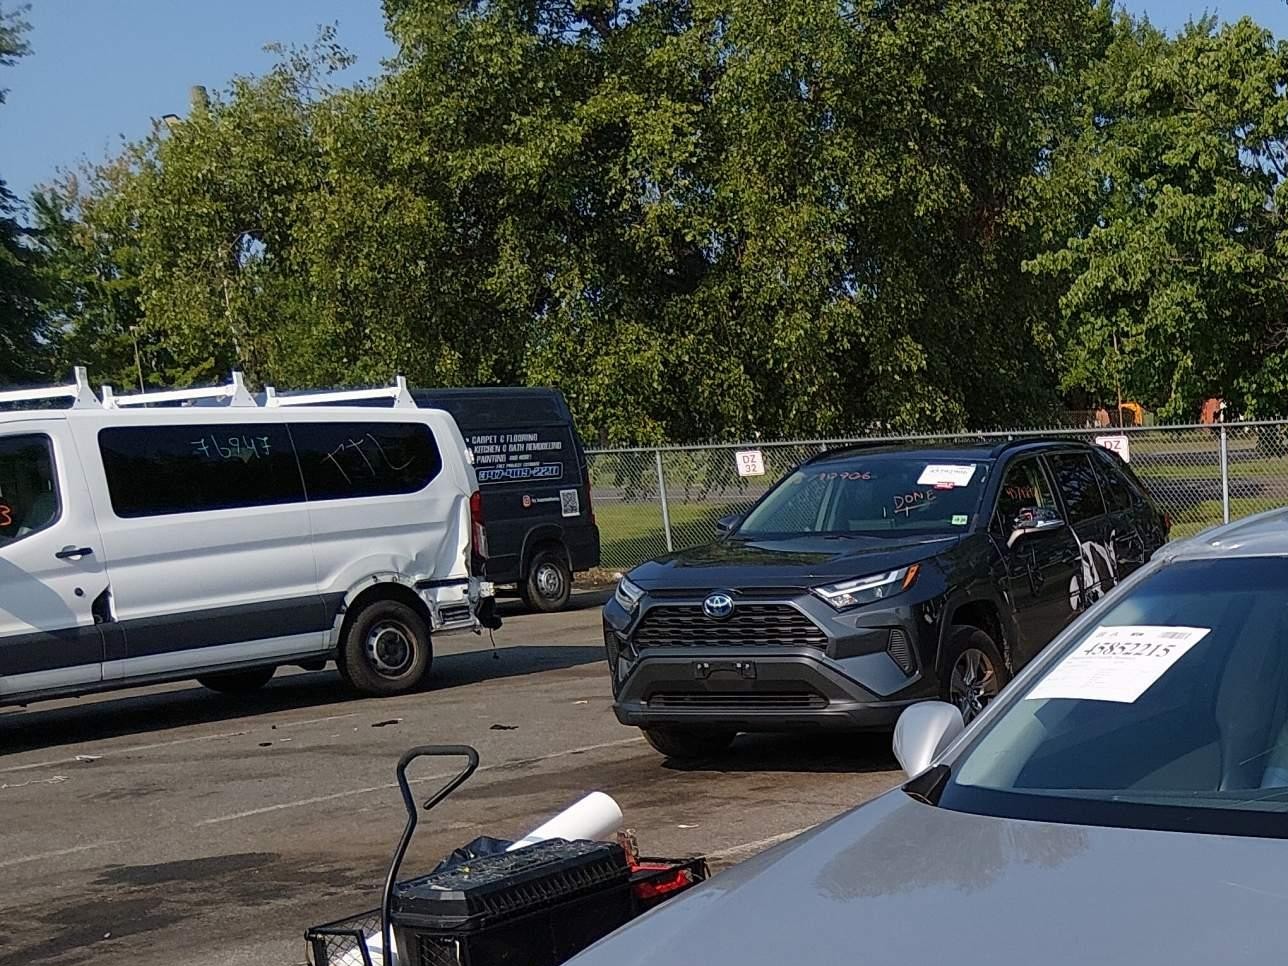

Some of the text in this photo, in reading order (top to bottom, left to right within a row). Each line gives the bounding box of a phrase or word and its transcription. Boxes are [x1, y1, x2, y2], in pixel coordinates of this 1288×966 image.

[472, 435, 497, 444] CARPET
[506, 433, 538, 443] FLOORING
[474, 444, 501, 454] KITCHEN
[509, 443, 525, 452] BATH
[1104, 440, 1122, 450] DZ
[476, 454, 506, 464] PAINTING
[742, 454, 757, 463] DZ
[745, 464, 757, 472] 32
[893, 489, 937, 509] DONE
[1084, 642, 1177, 657] 45852215
